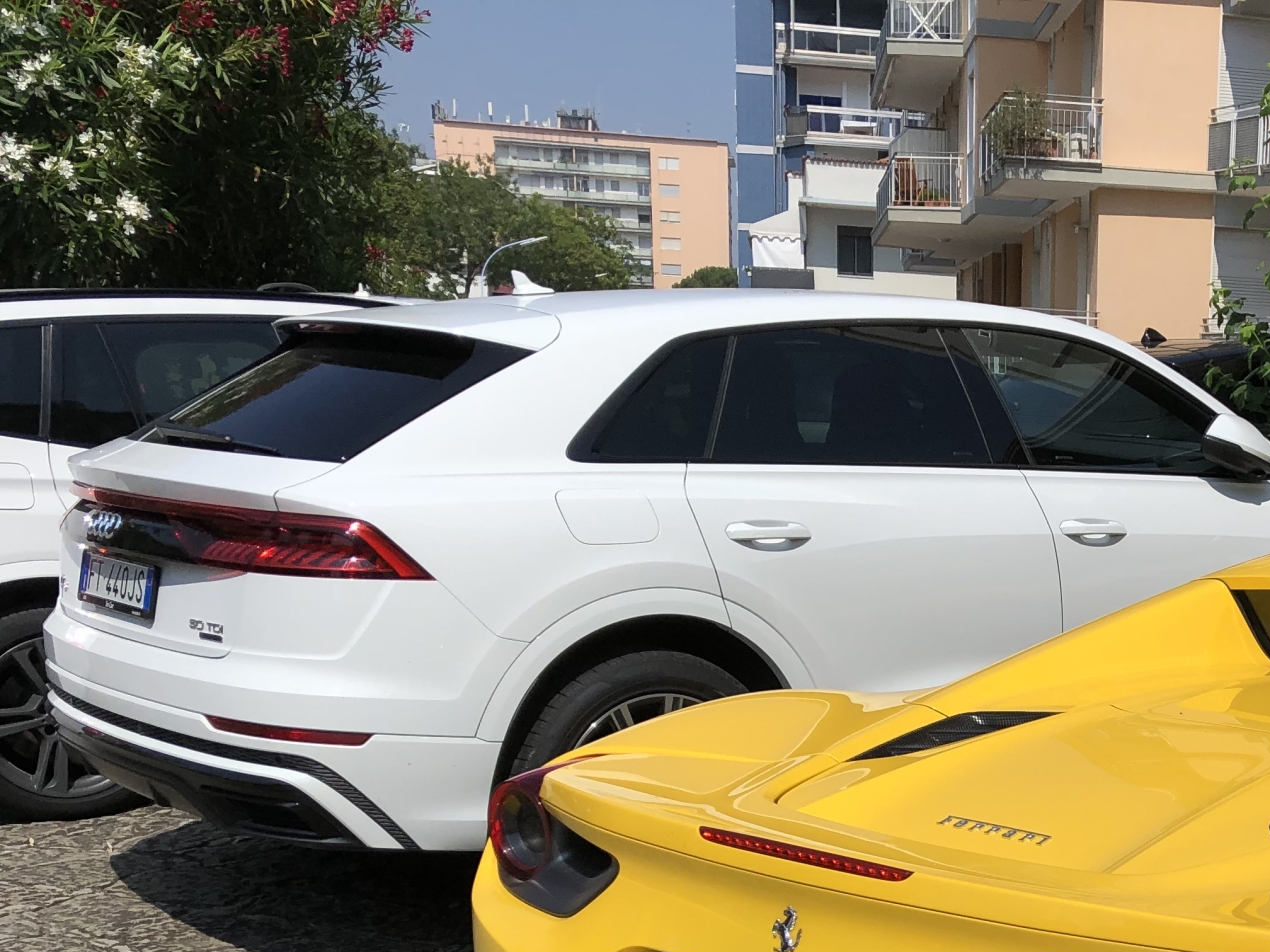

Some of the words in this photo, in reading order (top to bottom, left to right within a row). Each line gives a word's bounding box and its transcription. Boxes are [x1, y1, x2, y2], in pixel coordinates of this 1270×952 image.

[87, 559, 104, 592] FT
[106, 563, 145, 604] 440JS
[206, 621, 224, 635] TDI
[936, 814, 1053, 847] Ferrari
